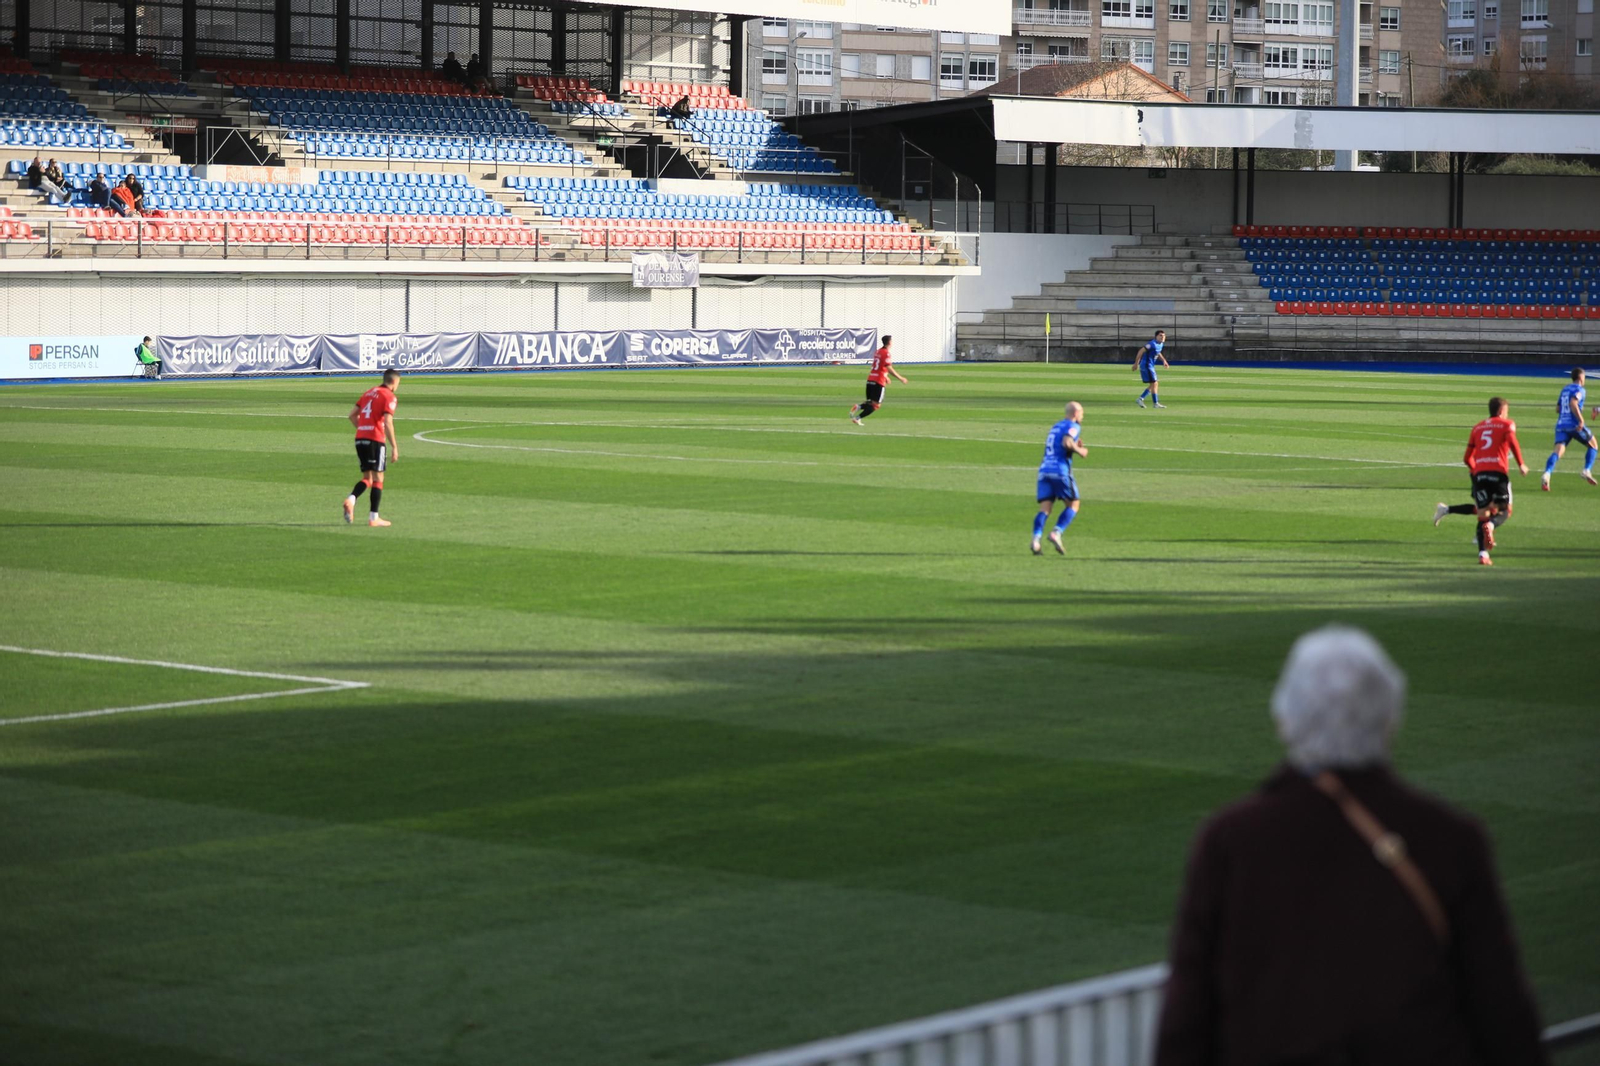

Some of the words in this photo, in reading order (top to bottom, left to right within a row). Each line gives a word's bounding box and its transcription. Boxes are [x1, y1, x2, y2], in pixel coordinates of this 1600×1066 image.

[648, 272, 684, 283] OURENSE
[381, 336, 420, 350] XUNTA
[503, 333, 607, 365] ABANCA
[651, 338, 719, 355] COPERSA
[798, 339, 834, 350] recoletas
[836, 338, 856, 349] salud
[45, 345, 99, 359] PERSAN
[171, 343, 232, 365] Estrella
[235, 341, 290, 366] Galicia
[381, 353, 395, 366] DE
[398, 352, 444, 366] GALICIA
[29, 361, 56, 370] STORES
[59, 361, 87, 369] PERSAN
[361, 400, 372, 418] 4
[1046, 433, 1055, 455] 9
[1480, 430, 1493, 450] 5
